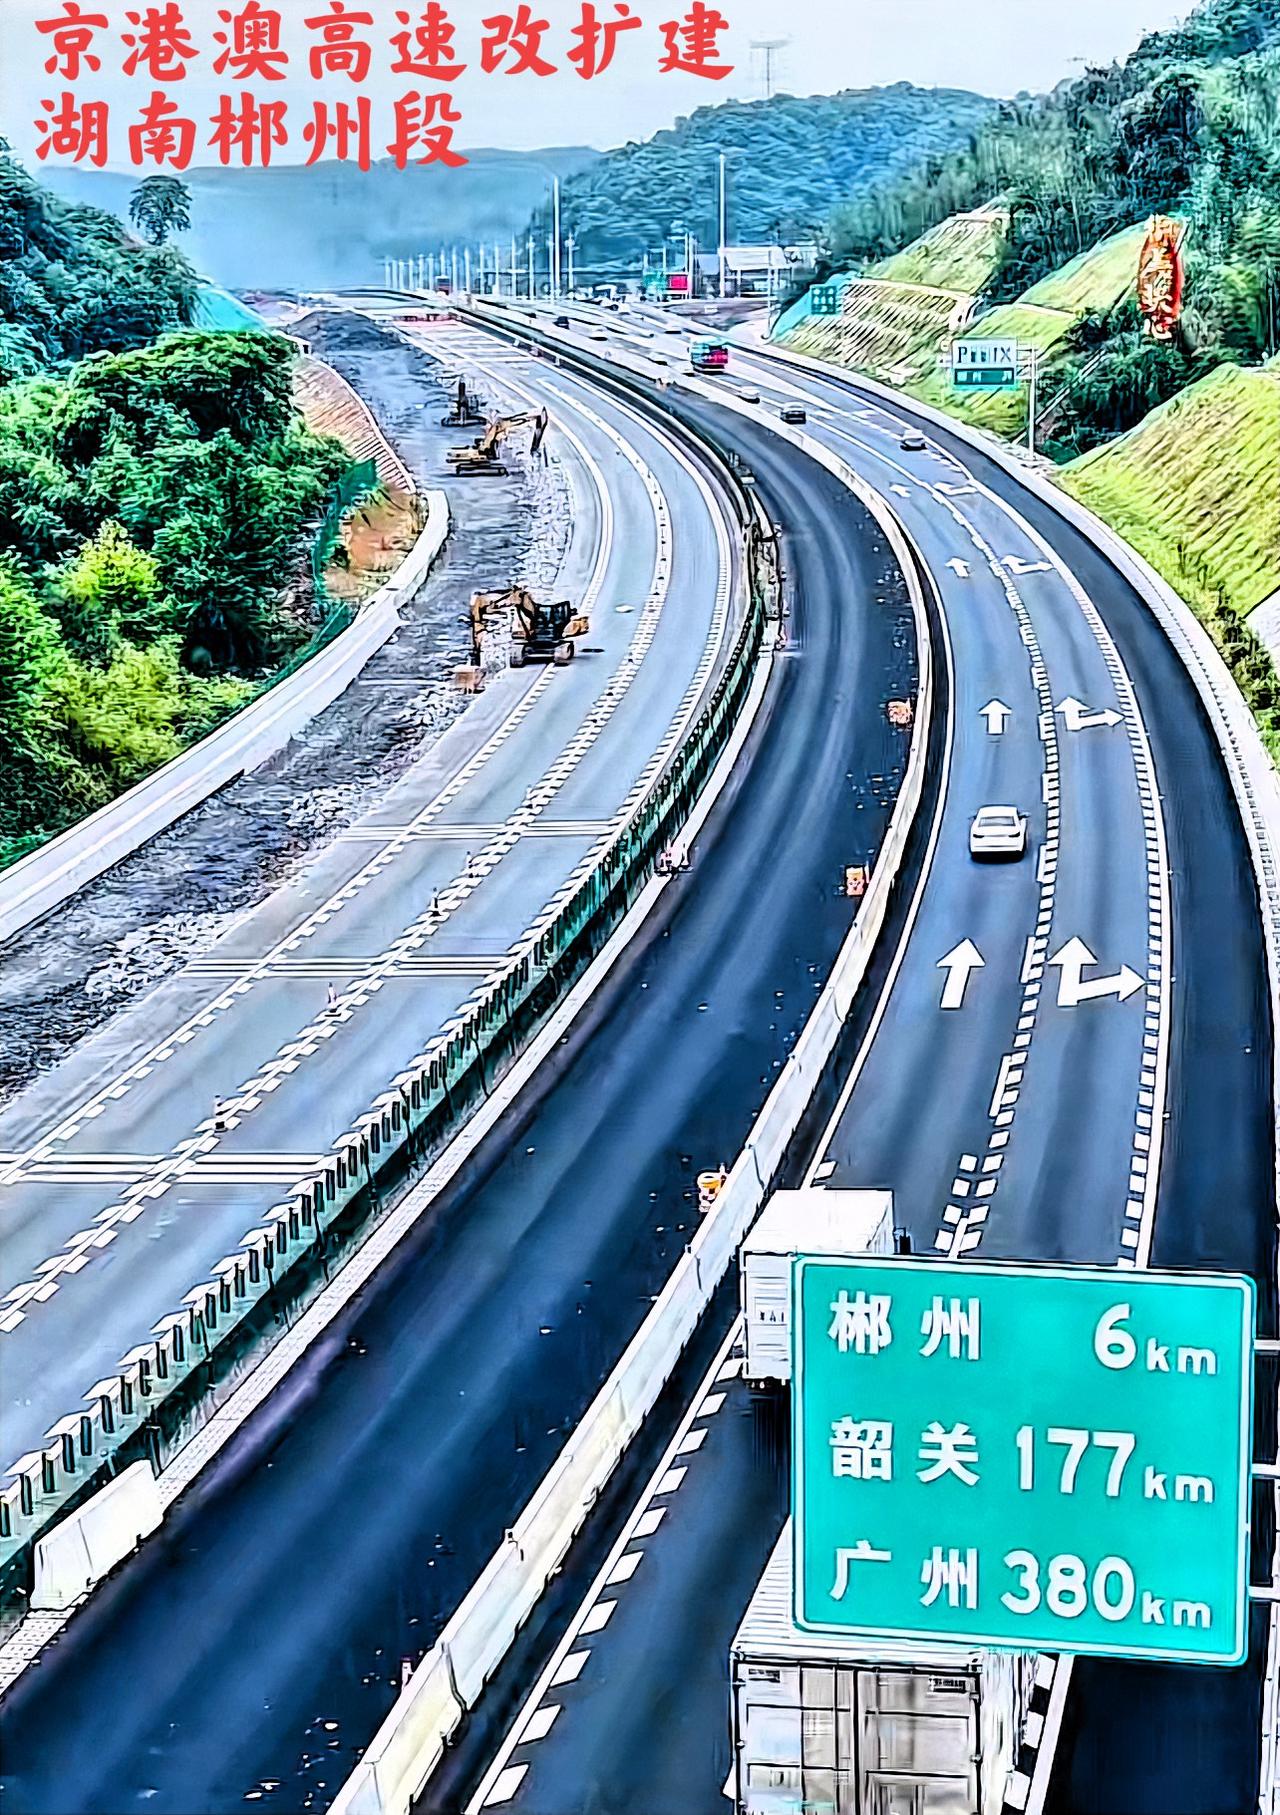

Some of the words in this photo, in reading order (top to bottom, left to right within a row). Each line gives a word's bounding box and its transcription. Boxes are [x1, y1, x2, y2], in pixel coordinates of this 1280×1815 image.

[828, 1289, 981, 1361] 郴州
[829, 1416, 980, 1487] 韶关
[829, 1539, 979, 1610] 广州
